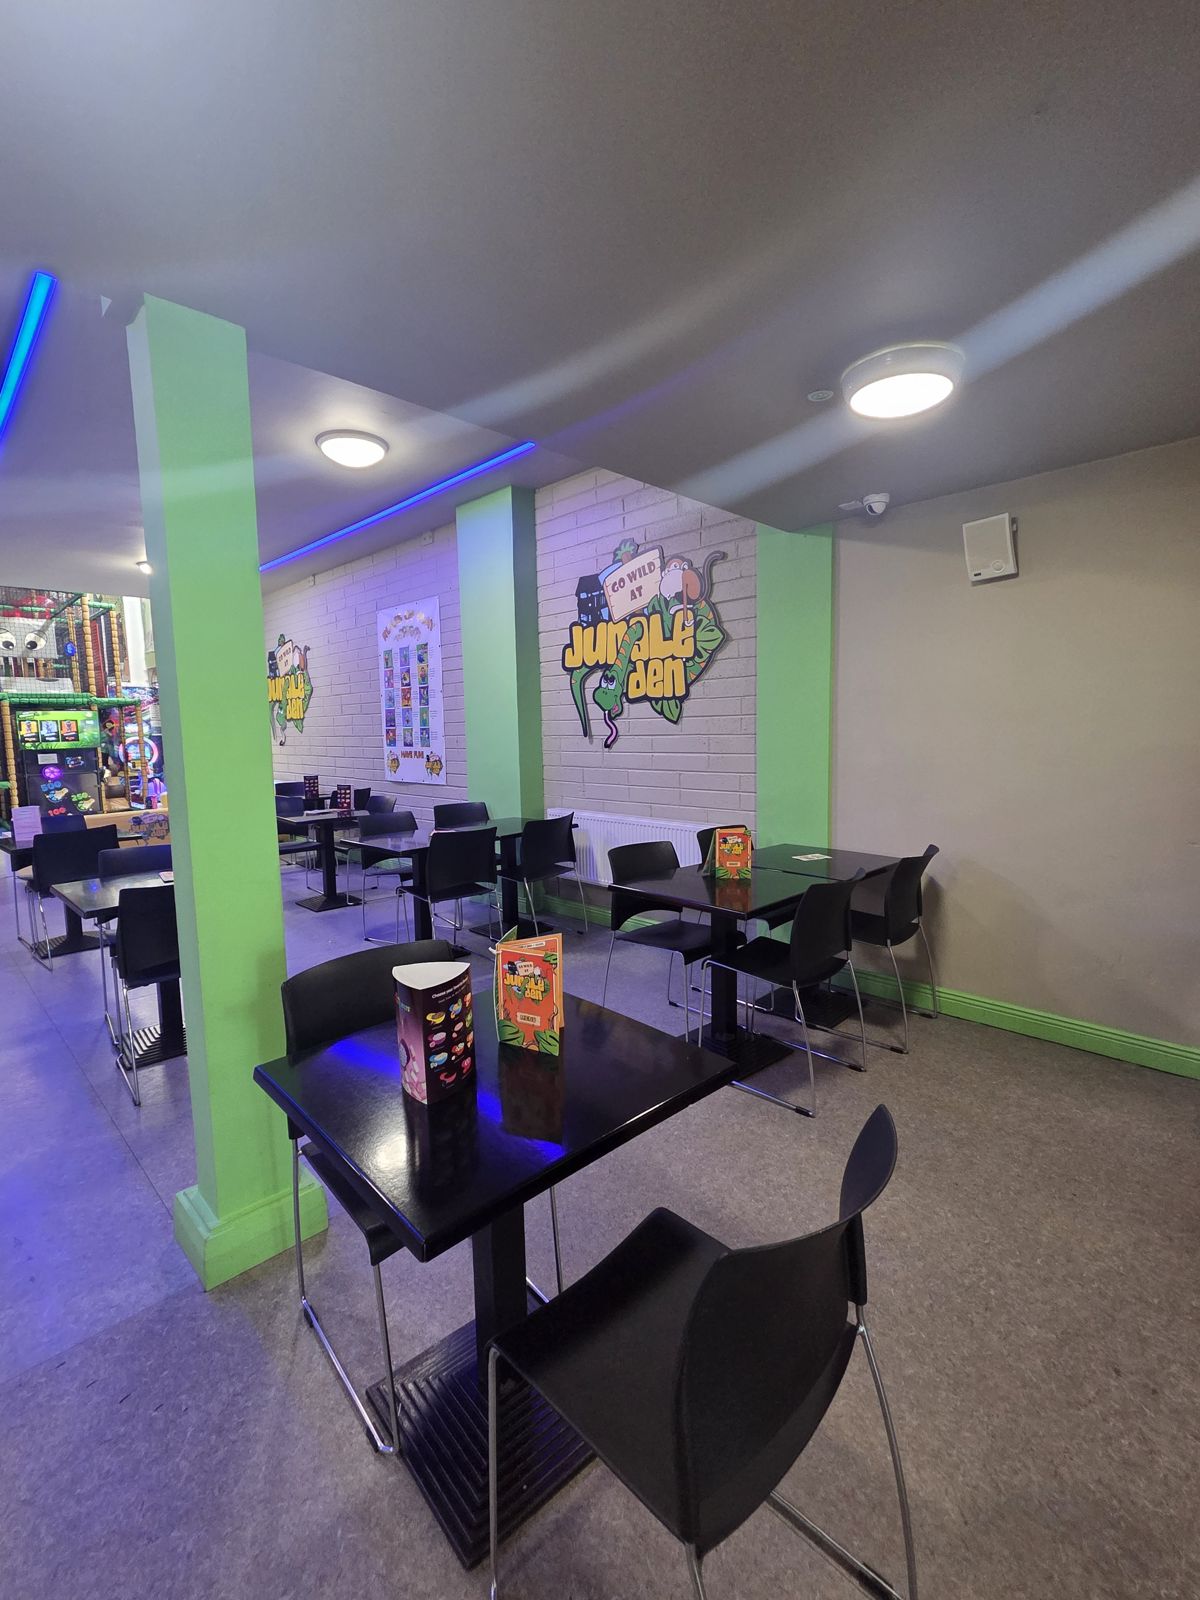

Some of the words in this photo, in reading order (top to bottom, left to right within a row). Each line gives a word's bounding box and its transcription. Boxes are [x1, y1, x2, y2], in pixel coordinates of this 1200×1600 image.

[611, 577, 626, 593] GO
[627, 561, 656, 583] WILD
[630, 585, 643, 601] AT
[71, 792, 89, 802] 250
[48, 807, 66, 816] 100
